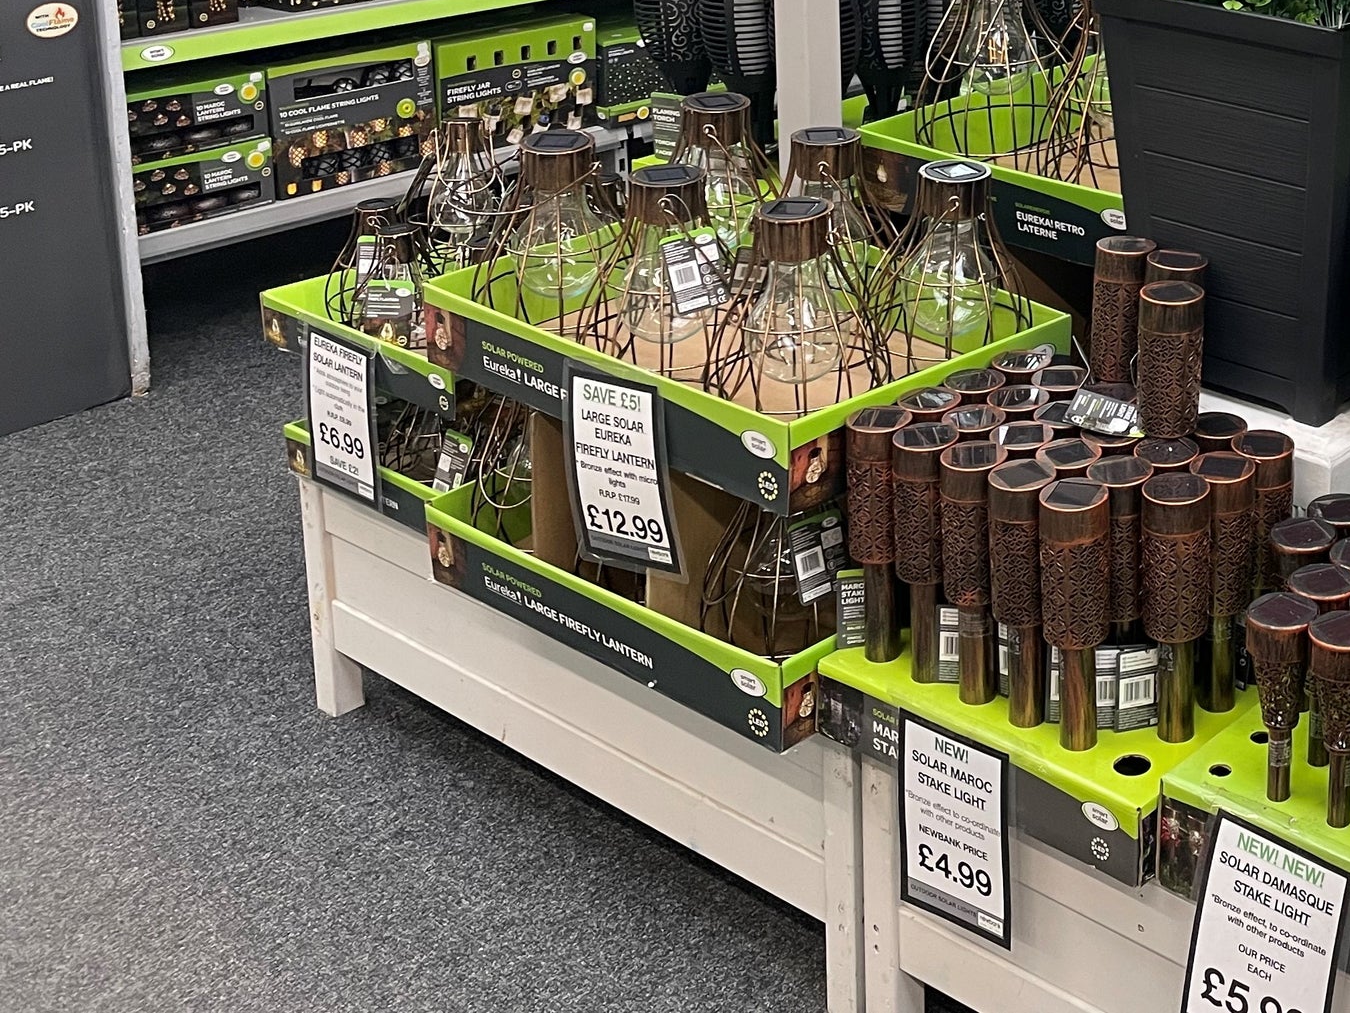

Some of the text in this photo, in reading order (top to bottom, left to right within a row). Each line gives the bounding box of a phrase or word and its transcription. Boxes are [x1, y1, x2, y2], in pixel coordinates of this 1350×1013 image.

[288, 108, 306, 117] COOL
[308, 104, 330, 114] FLAME
[332, 100, 355, 110] STRING
[356, 94, 379, 105] LIGHTS
[1, 201, 34, 218] 5-PK
[1016, 211, 1085, 237] EUREKA! RETRO
[1017, 222, 1058, 240] LATERNE
[314, 337, 363, 366] EUREKA FIREFLY
[313, 352, 333, 369] SOLAR
[333, 361, 363, 382] LANTERN
[583, 384, 641, 412] SAVE £5!
[582, 409, 644, 433] LARGE SOLAR
[319, 422, 364, 459] £6.99
[595, 428, 631, 446] EUREKA
[576, 442, 654, 469] FIREFLY LANTERN
[588, 504, 663, 543] £12.99
[484, 576, 653, 669] Eureka! LARGE FIREFLY LANTERN
[935, 737, 969, 763] NEW!
[912, 750, 992, 794] SOLAR MAROC
[918, 772, 986, 811] STAKE LIGHT
[918, 843, 992, 897] £4.99
[1237, 832, 1325, 888] NEW! NEW!
[1219, 851, 1334, 916] SOLAR DAMASQUE
[1234, 881, 1311, 927] STAKE LIGHT
